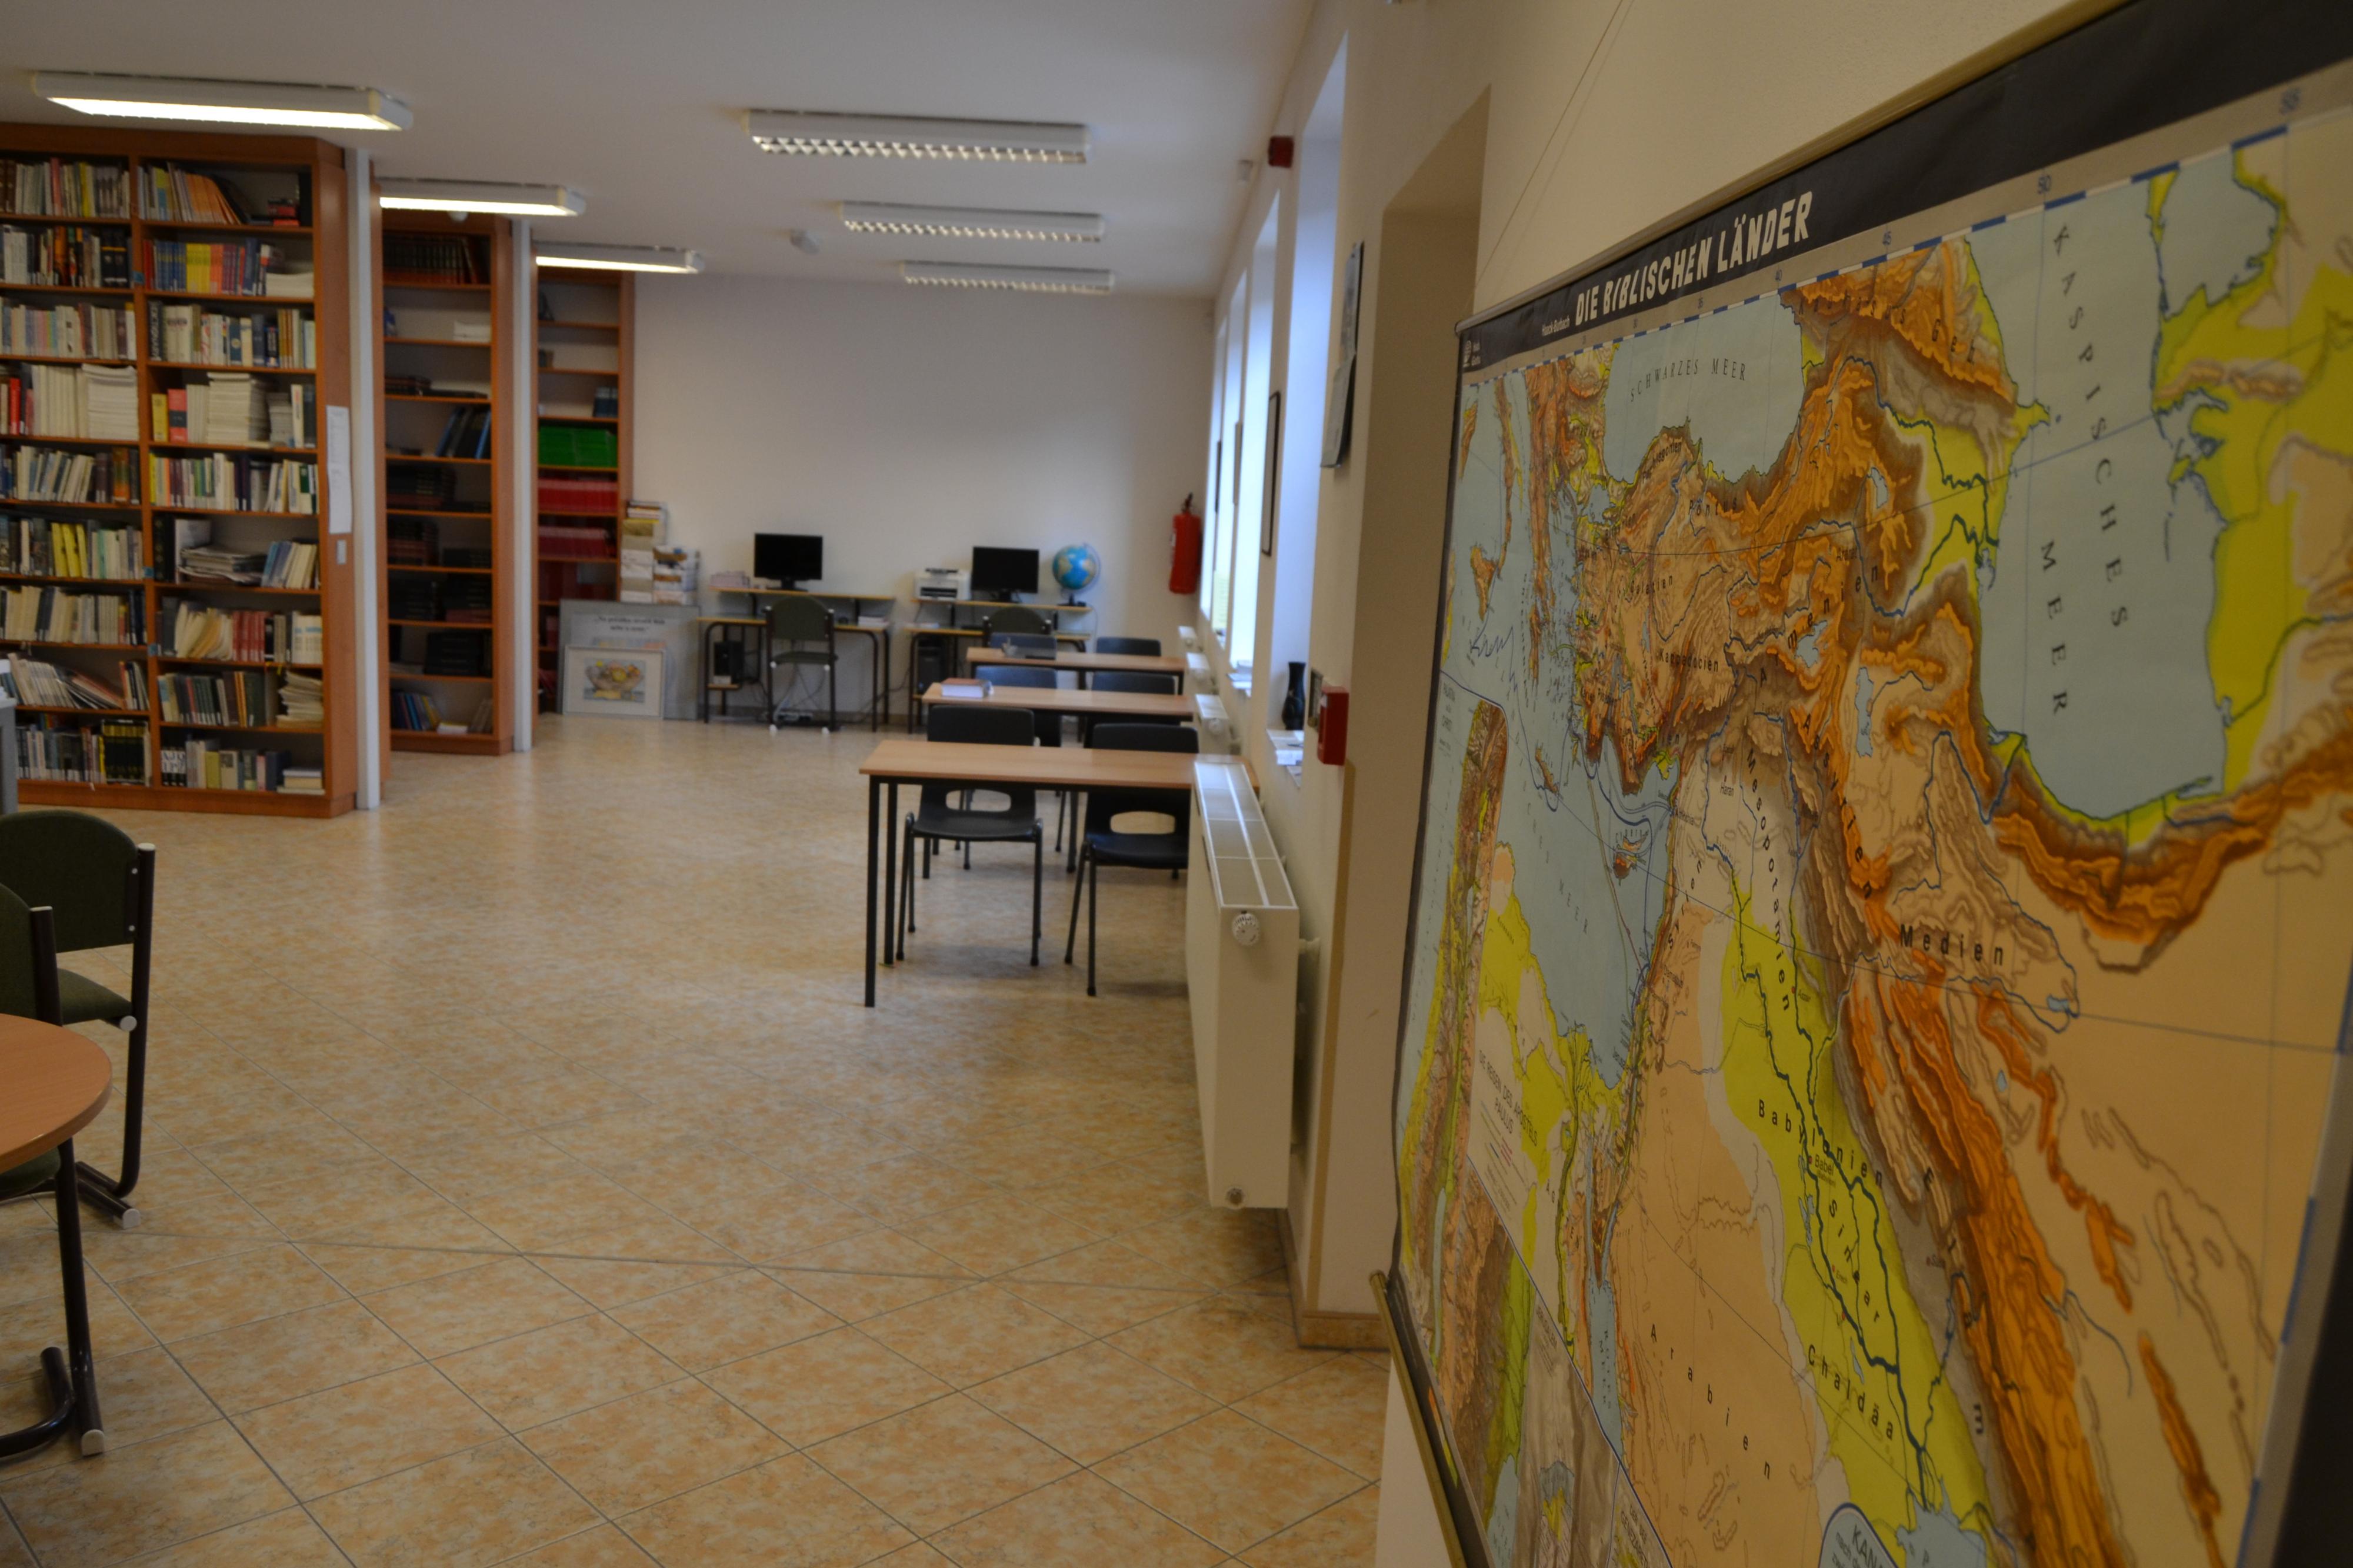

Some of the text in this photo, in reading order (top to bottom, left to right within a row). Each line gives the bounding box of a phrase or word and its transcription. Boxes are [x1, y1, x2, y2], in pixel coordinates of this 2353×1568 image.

[1575, 285, 1600, 326] DIE
[1603, 236, 1712, 315] BIBLISCHEN
[1717, 191, 1812, 273] LÄNDER
[1630, 358, 1746, 402] SCHWARZES MEER
[2054, 225, 2128, 628] KASPISCHES
[1689, 498, 1737, 516] Pontus
[2040, 539, 2068, 715] MEER
[1659, 648, 1719, 672] Kappadocien
[1747, 748, 1789, 1011] Mesopotamien
[1901, 923, 2004, 966] Medien
[1494, 1097, 1514, 1134] PAULUS
[1503, 1085, 1512, 1108] DES
[1758, 1099, 1882, 1188] Babylonien
[1814, 1155, 1834, 1176] Babel
[1651, 1323, 1770, 1480] Arabien
[1808, 1344, 1894, 1440] Chaldäa
[1852, 1524, 1883, 1568] KAN
